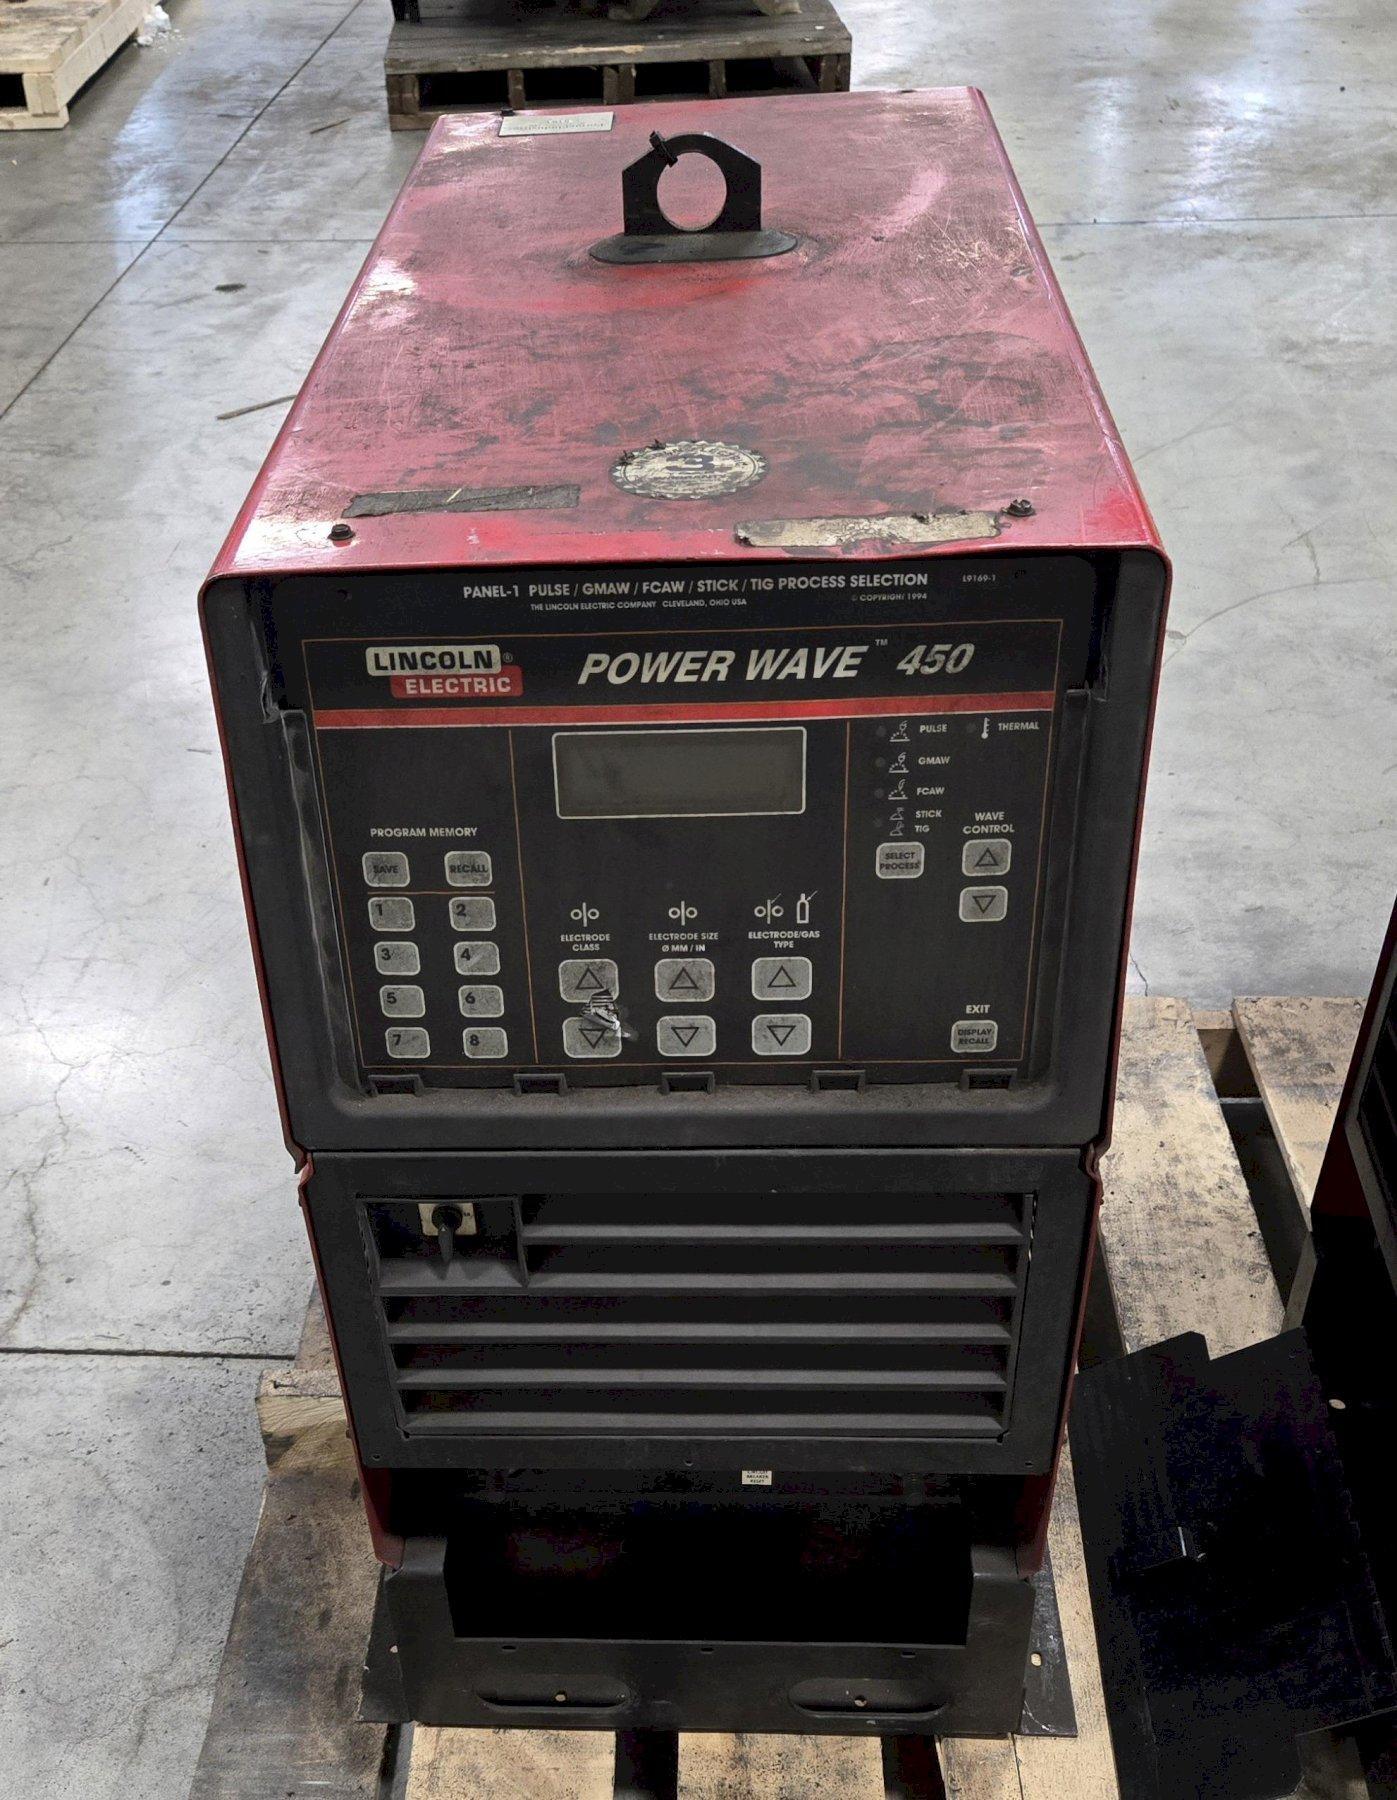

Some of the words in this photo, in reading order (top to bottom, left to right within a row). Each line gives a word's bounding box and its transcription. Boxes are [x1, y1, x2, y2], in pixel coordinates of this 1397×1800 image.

[463, 584, 520, 598] PANEL-1
[528, 583, 571, 597] PULSE
[582, 582, 630, 596] GMAW
[642, 580, 685, 594] FCAW
[697, 578, 739, 592] STICK
[750, 577, 775, 591] TIG
[778, 575, 846, 590] PROCESS
[849, 573, 928, 588] SELECTION
[907, 592, 928, 600] 1994
[530, 603, 544, 611] THE
[545, 602, 579, 611] LINCOLN
[580, 601, 616, 611] ELECTRIC
[616, 600, 657, 609] COMPANY
[662, 599, 708, 608] CLEVELAND,
[709, 598, 730, 607] OHIO
[731, 598, 747, 606] USA
[373, 650, 494, 672] LINCOLN
[577, 650, 736, 685] POWER
[745, 645, 870, 682] WAVE
[896, 643, 976, 676] 450
[405, 677, 512, 695] ELECTRIC
[919, 723, 948, 733] PULSE
[998, 721, 1040, 731] THERMAL
[918, 755, 951, 765] GMAW
[916, 786, 945, 796] FCAW
[915, 809, 942, 818] STICK
[974, 811, 1006, 821] WAVE
[370, 827, 427, 838] PROGRAM
[429, 827, 478, 838] MEMORY
[914, 824, 930, 833] TIG
[962, 824, 1016, 835] CONTROL
[885, 851, 916, 860] SELECT
[373, 864, 400, 874] SAVE
[449, 863, 489, 874] RECALL
[880, 861, 920, 870] PROCESS
[375, 903, 383, 917] 1
[455, 903, 467, 917] 2
[560, 933, 611, 943] ELECTRODE
[648, 932, 699, 941] ELECTRODE
[700, 931, 720, 941] SIZE
[747, 930, 821, 940] ELECTRODE/GAS
[572, 943, 601, 952] CLASS
[671, 944, 689, 952] MM
[695, 943, 706, 952] IN
[774, 940, 795, 949] TYPE
[381, 947, 392, 961] 3
[460, 947, 471, 961] 4
[386, 991, 397, 1004] 5
[465, 991, 476, 1005] 6
[965, 1004, 991, 1014] EXIT
[957, 1028, 992, 1036] DISPLAY
[392, 1034, 402, 1046] 7
[469, 1034, 480, 1047] 8
